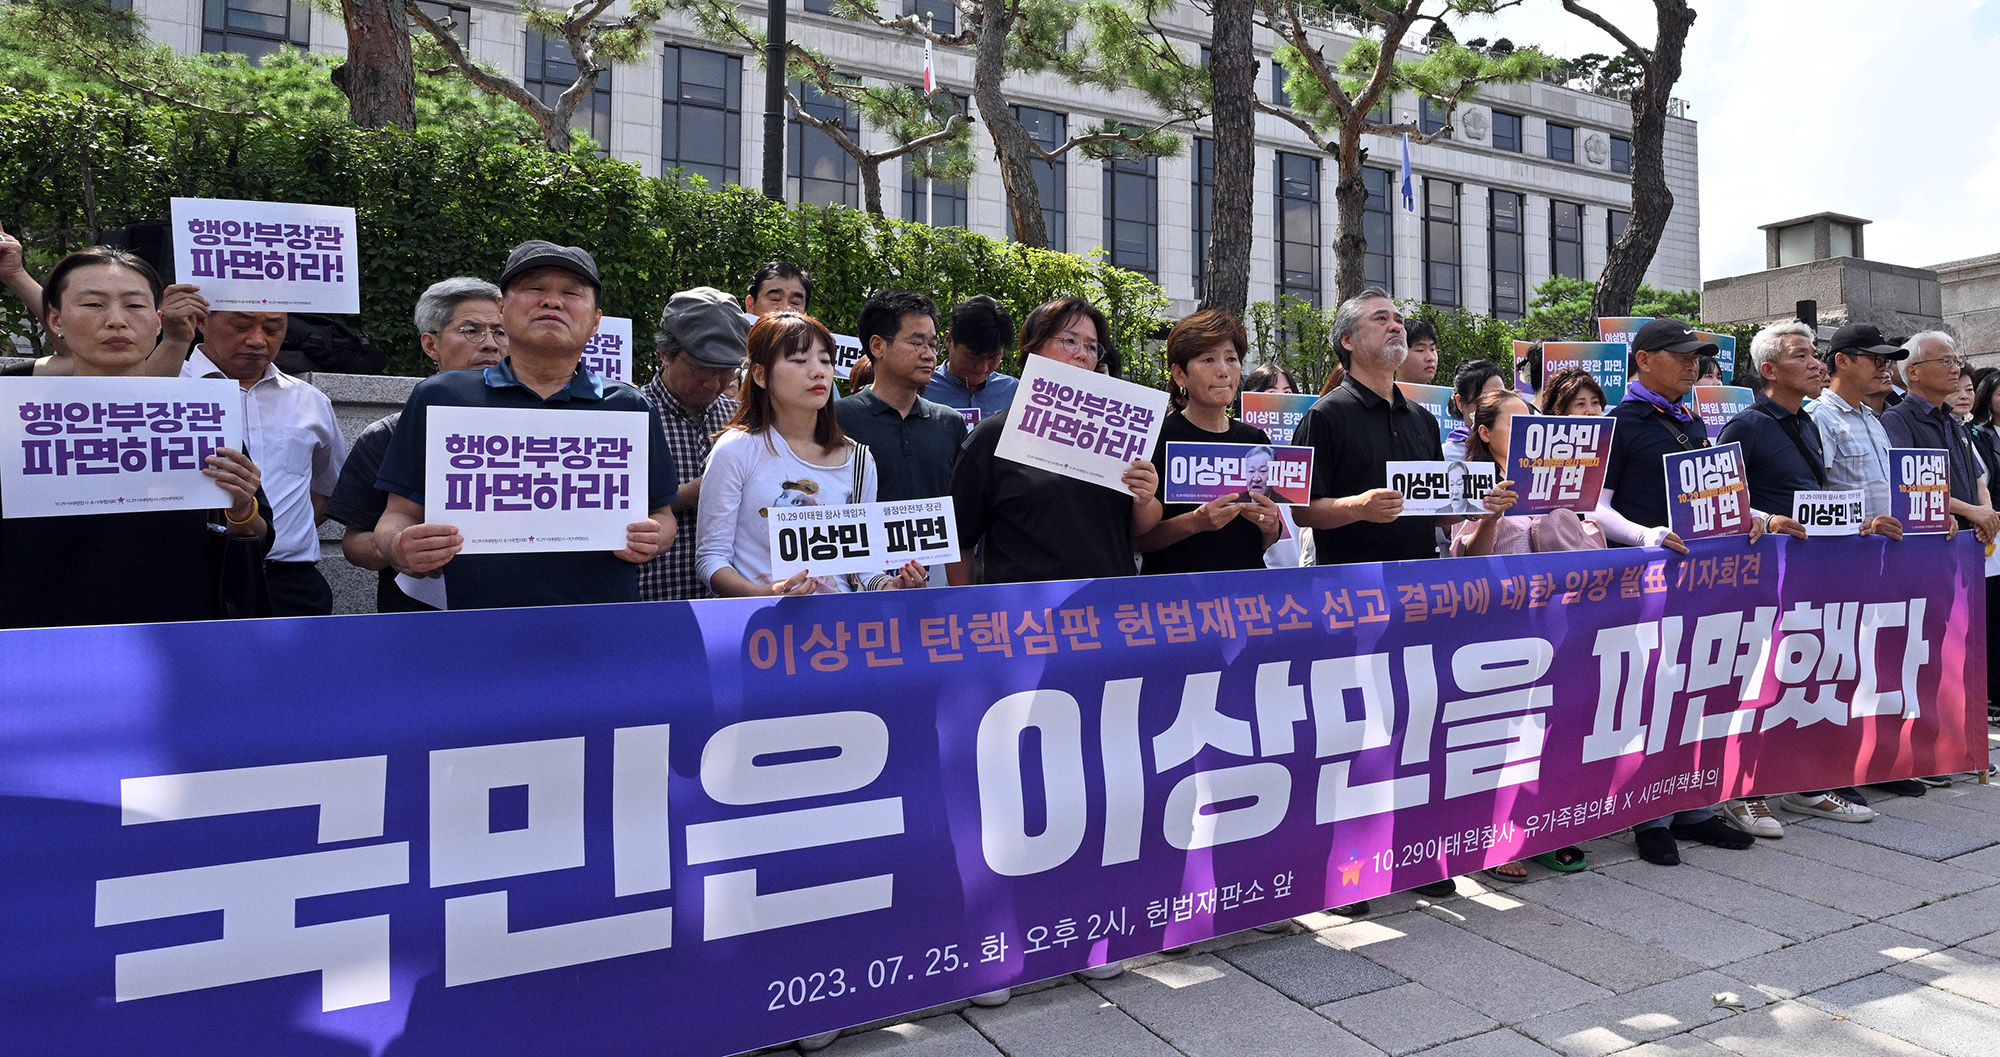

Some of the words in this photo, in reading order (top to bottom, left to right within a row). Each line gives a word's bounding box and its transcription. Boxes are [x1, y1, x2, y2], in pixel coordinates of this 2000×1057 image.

[188, 218, 344, 251] 행안부장관
[190, 248, 344, 282] 파면하라!
[1603, 359, 1625, 373] 파면,
[1603, 375, 1622, 388] 시작
[18, 401, 226, 436] 행안부장관
[1030, 377, 1155, 435] 행안부장관
[1245, 410, 1280, 425] 이상민
[445, 433, 633, 470] 행안부장관
[1017, 404, 1147, 464] 파면하라!
[1525, 423, 1601, 460] 이상민
[1170, 456, 1248, 487] 이상민
[1266, 460, 1307, 488] 파면
[1518, 457, 1543, 468] 10.29
[1680, 450, 1740, 493] 이상민
[1901, 455, 1947, 486] 이상민
[445, 472, 630, 512] 파면하라!
[1392, 472, 1450, 500] 이상민
[1462, 473, 1494, 500] 파면
[1528, 465, 1586, 501] 파면
[776, 512, 798, 522] 10.29
[798, 510, 824, 521] 이태원
[824, 509, 841, 520] 참사
[842, 507, 867, 519] 책임자
[883, 504, 924, 516] 행정안전부
[925, 502, 942, 512] 장관
[1690, 490, 1742, 533] 파면
[1798, 503, 1847, 526] 이상민
[1908, 490, 1945, 521] 파면
[778, 522, 870, 562] 이상민
[884, 516, 949, 553] 파면
[749, 617, 904, 676] 이상민
[920, 605, 1102, 663] 탄핵심판
[1114, 594, 1313, 647] 헌법재판소
[1321, 588, 1390, 630] 선고
[1397, 578, 1491, 622] 결과에
[1500, 572, 1556, 610] 대한
[1561, 568, 1614, 605] 입장
[1620, 558, 1668, 599] 발표
[1676, 552, 1761, 593] 기자회견
[94, 710, 905, 1013] 국민은
[976, 637, 1554, 876] 이상민을
[1582, 598, 1930, 764] 파면했다
[1373, 819, 1515, 874] 10.29이태원참사
[1523, 795, 1618, 838] 유가족협의회
[1622, 790, 1635, 809] X
[1637, 767, 1720, 805] 시민대책회의
[767, 969, 856, 1012] 2023.
[867, 956, 914, 990] 07.
[925, 946, 969, 977] 25.
[980, 931, 1009, 964] 화
[1024, 917, 1080, 957] 오후
[1087, 905, 1136, 940] 2시,
[1146, 879, 1265, 926] 헌법재판소
[1271, 870, 1294, 899] 앞
